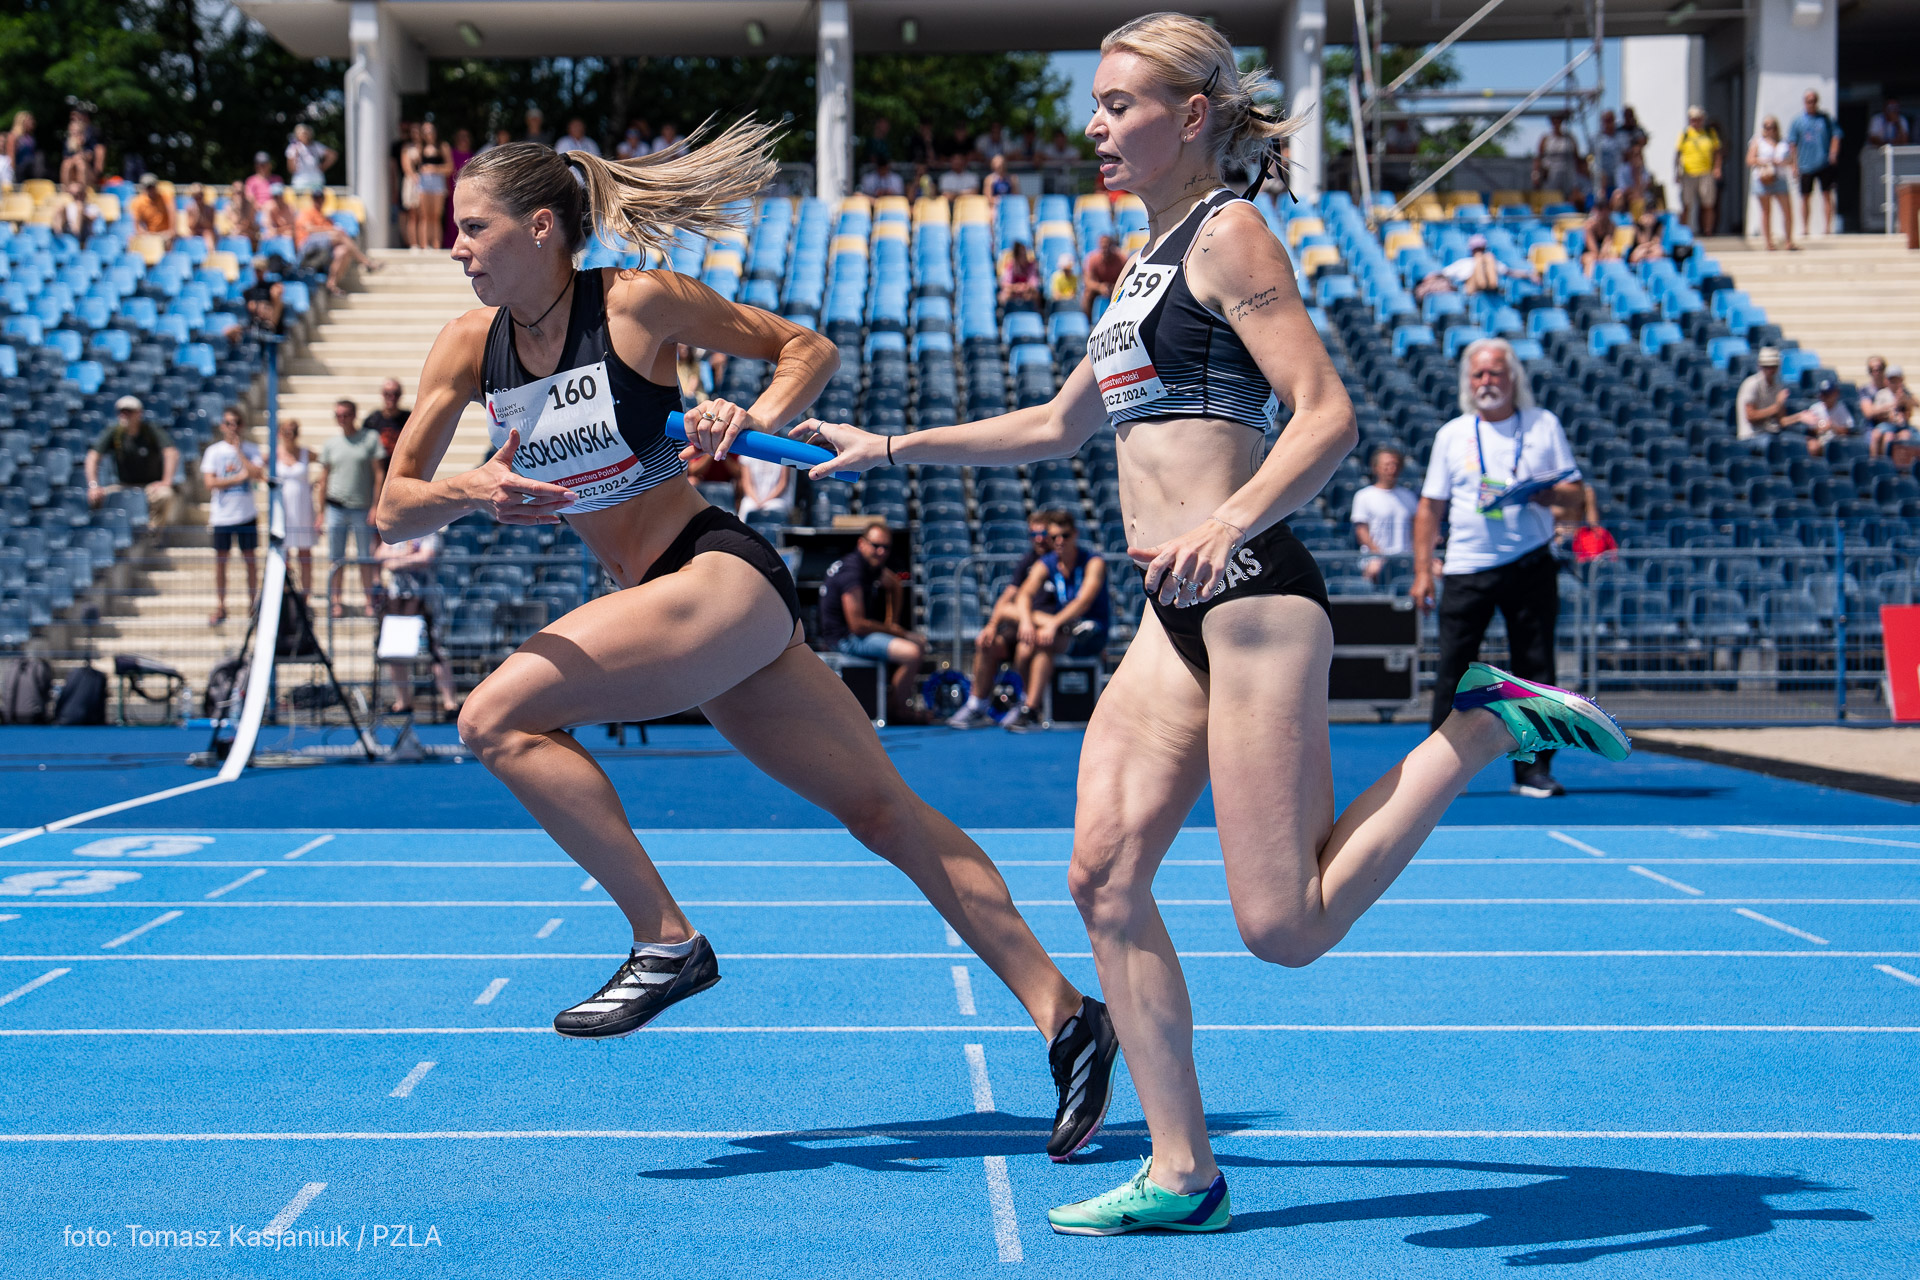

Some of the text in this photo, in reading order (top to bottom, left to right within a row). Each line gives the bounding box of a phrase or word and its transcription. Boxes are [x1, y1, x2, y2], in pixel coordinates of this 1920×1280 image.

[1127, 272, 1162, 298] 59
[1122, 371, 1140, 383] Polski
[547, 375, 597, 411] 160
[1122, 386, 1148, 403] 2024
[497, 406, 526, 419] POMORZE
[598, 465, 620, 478] Polski
[598, 476, 629, 494] 2024
